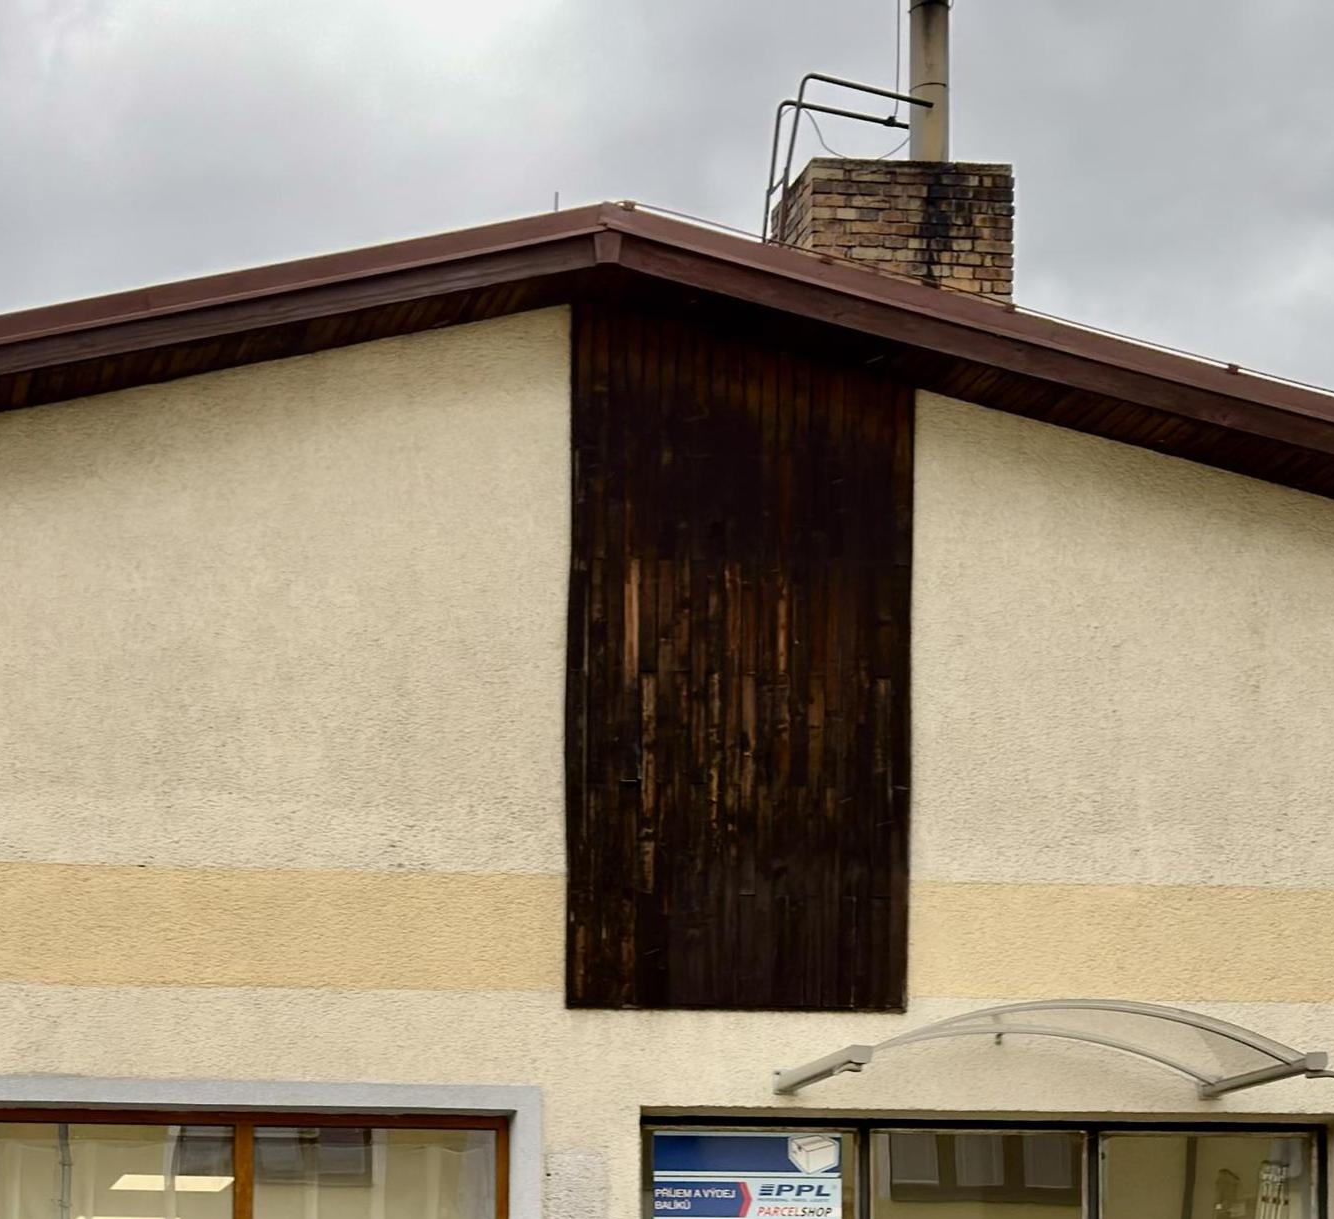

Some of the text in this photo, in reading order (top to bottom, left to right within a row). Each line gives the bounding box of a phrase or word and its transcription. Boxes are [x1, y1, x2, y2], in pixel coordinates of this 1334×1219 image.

[694, 1189, 703, 1199] A
[775, 1183, 832, 1197] PPL
[756, 1206, 833, 1218] PARCELSHOP
